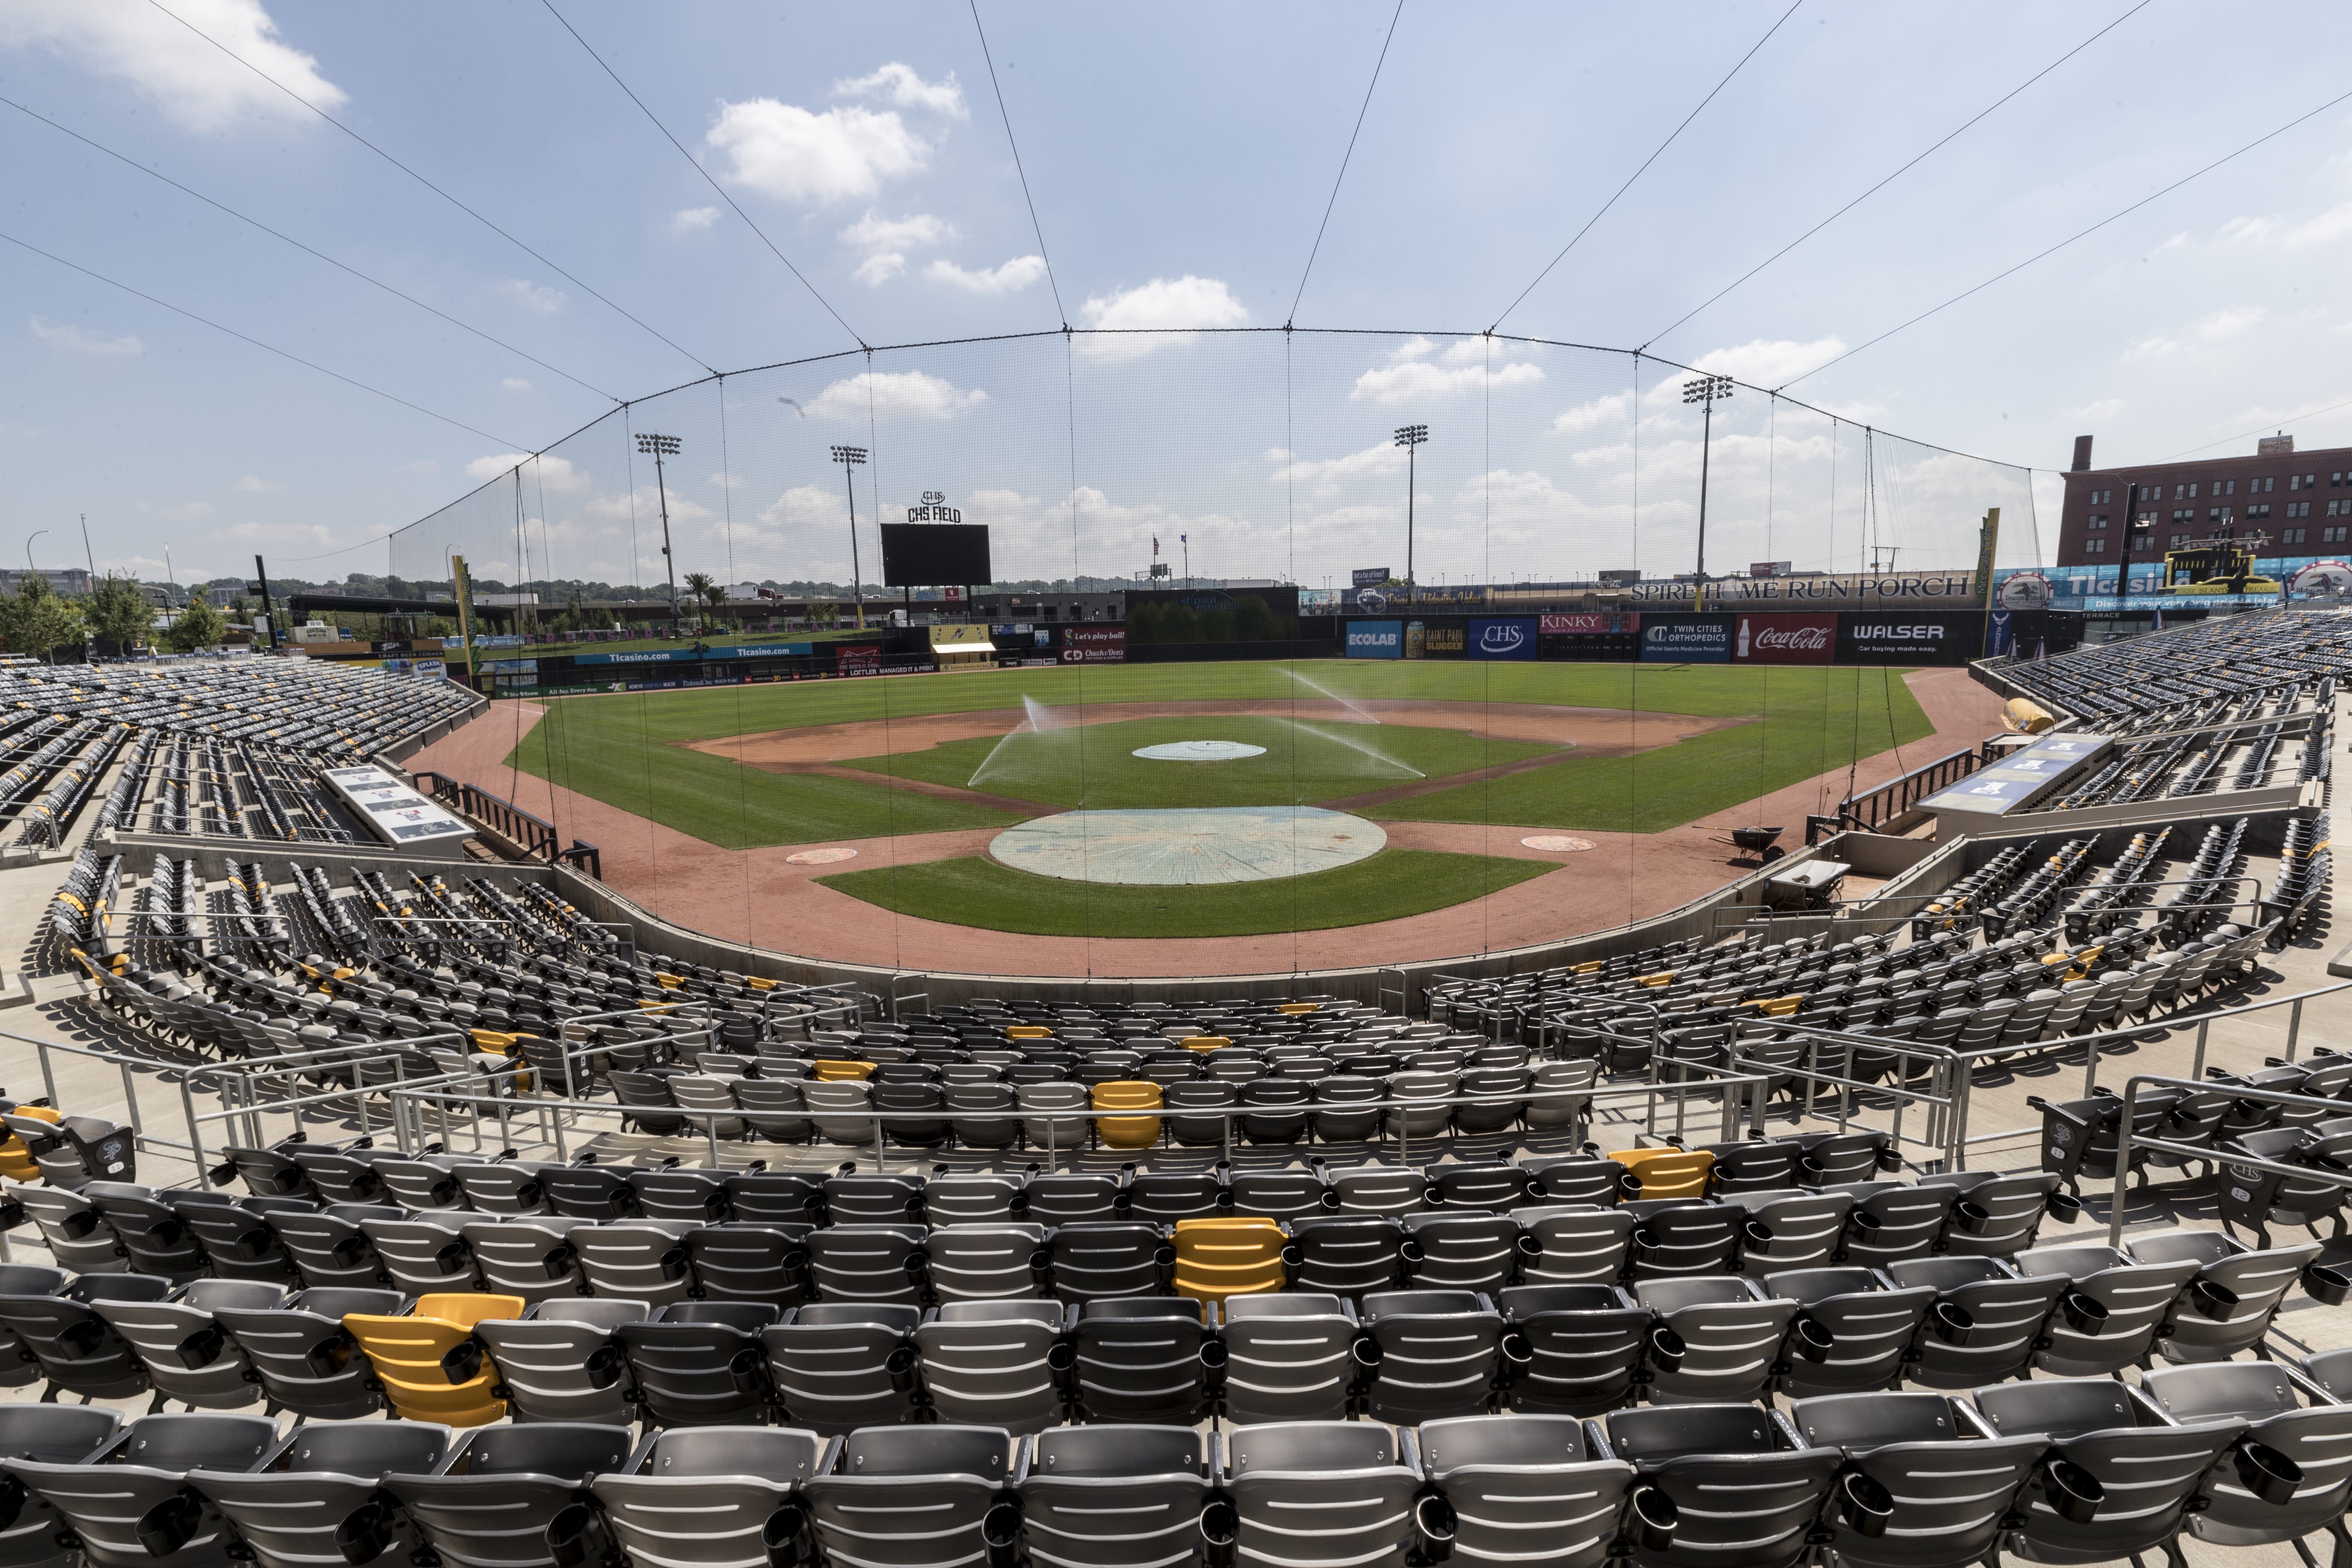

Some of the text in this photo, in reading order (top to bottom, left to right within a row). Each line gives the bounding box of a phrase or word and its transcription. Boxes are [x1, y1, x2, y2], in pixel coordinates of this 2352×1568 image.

[923, 491, 943, 499] CHS
[908, 506, 961, 524] CHS FIELD
[1978, 525, 1993, 594] Minnesota Corn
[1594, 580, 1623, 588] SPIRE
[1630, 584, 1696, 601] SPIRE
[1787, 580, 1849, 599] RUN
[1857, 577, 1969, 597] PORCH
[461, 572, 475, 634] Minnesota Corn
[1194, 596, 1216, 605] paul
[1387, 593, 1408, 605] Driven
[1419, 591, 1457, 605] Midwestern
[1458, 591, 1481, 604] Values
[1540, 615, 1599, 629] KINKY
[1092, 632, 1108, 641] play
[1426, 629, 1463, 642] SAINT PAUL
[1485, 625, 1520, 642] CHS
[1853, 625, 1944, 639] WALSER
[1349, 634, 1396, 645] ECOLAB
[1755, 627, 1832, 649] Coca-Cola
[1426, 642, 1463, 650] SLUGGER
[609, 653, 670, 662] TIcasino.com
[738, 648, 789, 656] TIcasino.com
[419, 661, 441, 669] SPLASH
[2054, 1148, 2061, 1157] 11
[2235, 1189, 2247, 1200] 12
